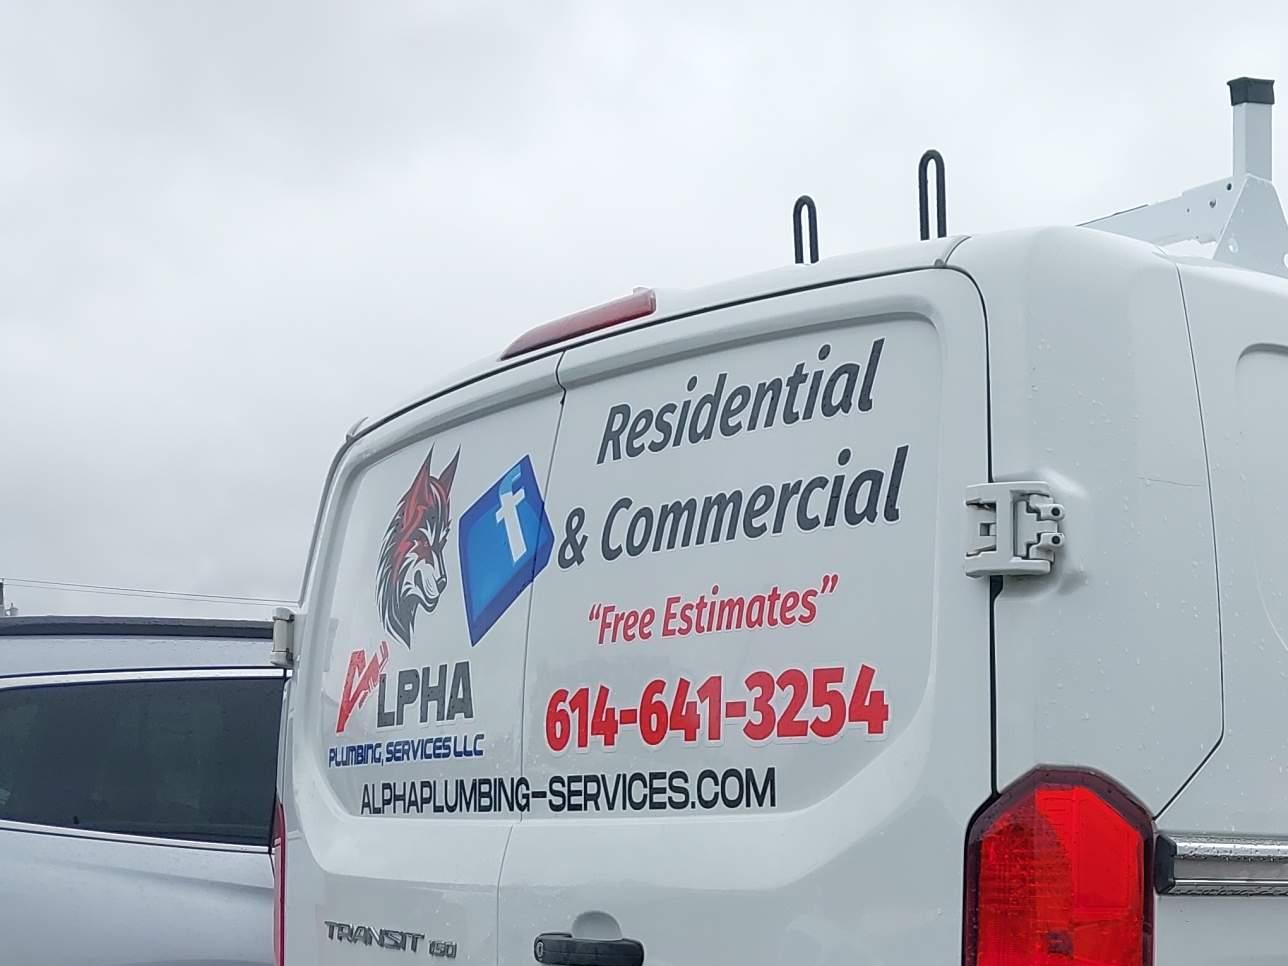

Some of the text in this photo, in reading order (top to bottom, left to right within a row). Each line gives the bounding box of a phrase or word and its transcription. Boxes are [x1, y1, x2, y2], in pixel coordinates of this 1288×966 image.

[596, 338, 886, 464] Residential
[558, 446, 909, 569] & Commercial
[546, 665, 889, 751] 614-641-3254
[386, 736, 450, 763] SERVICES
[453, 733, 485, 758] LLC
[360, 766, 777, 815] ALPHAPLUMBING-SERVICES.COM
[325, 921, 425, 952] TRANSIT
